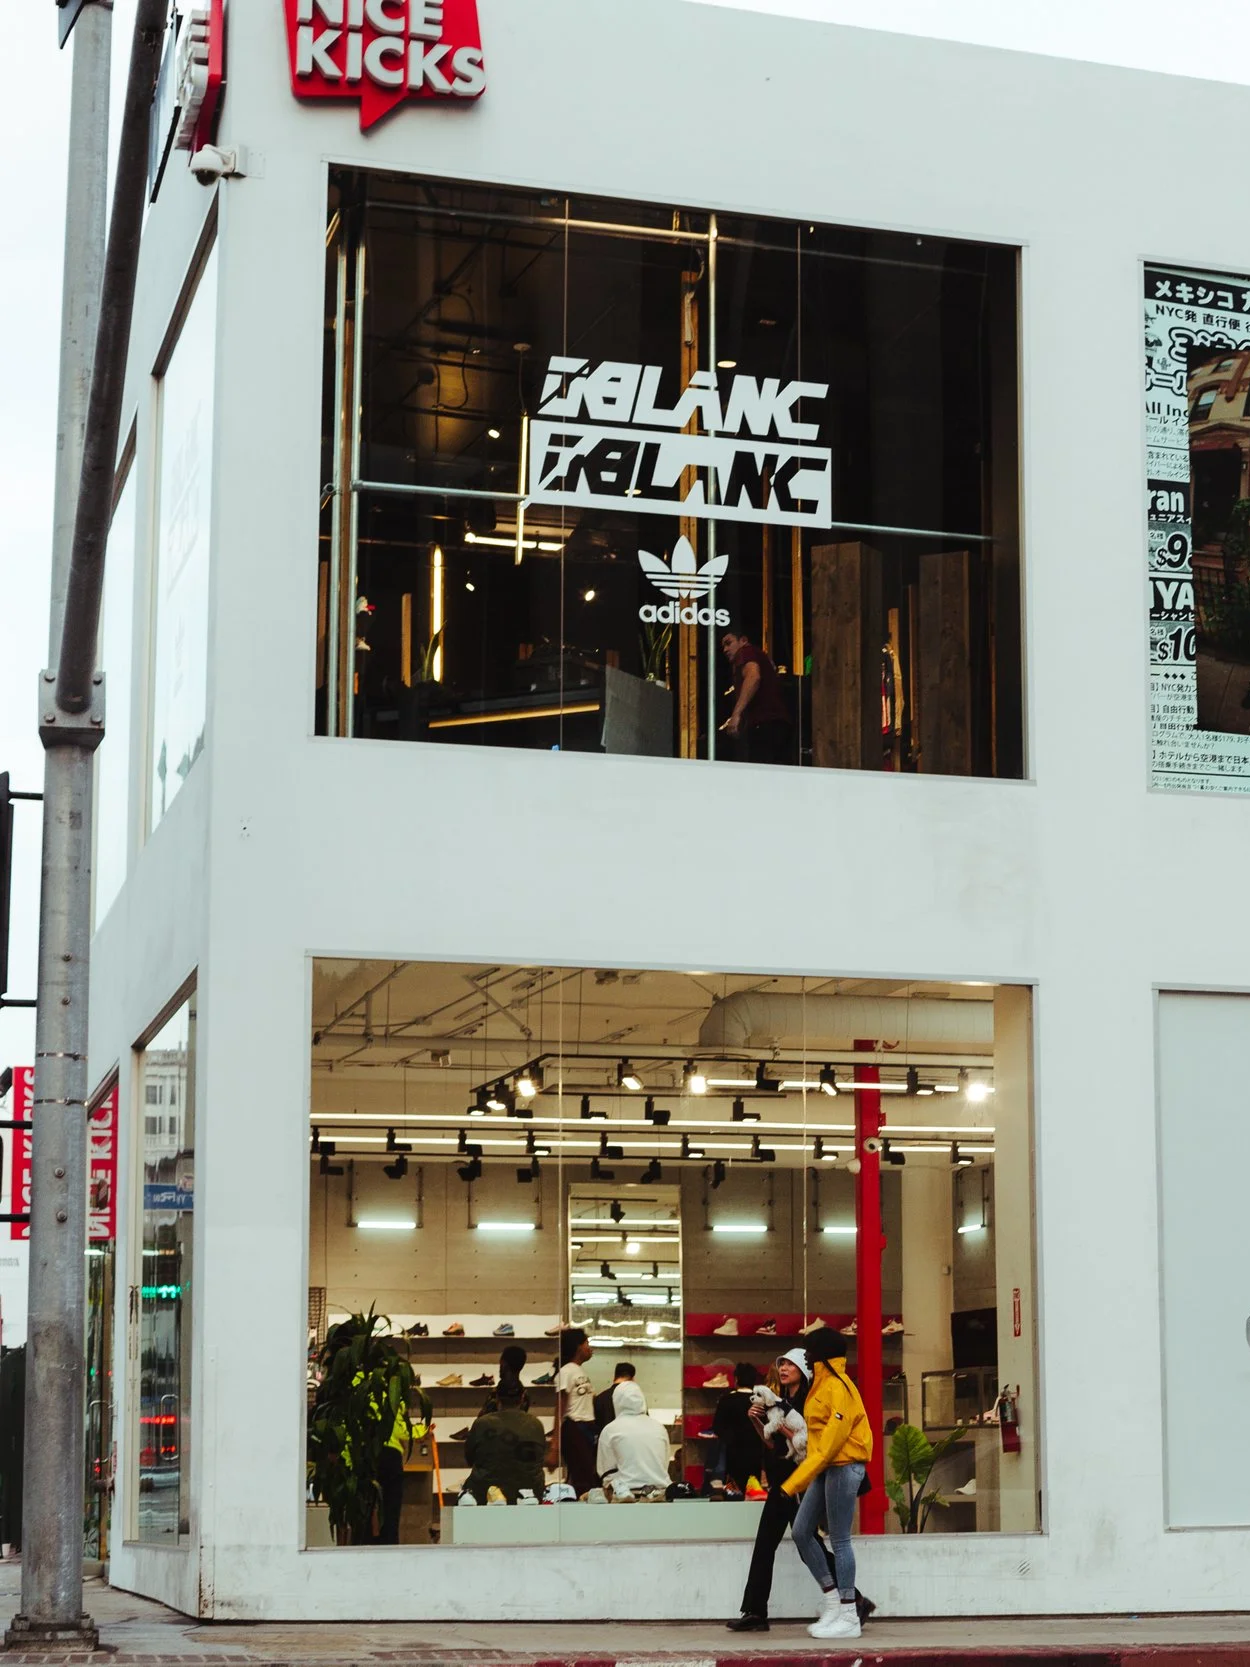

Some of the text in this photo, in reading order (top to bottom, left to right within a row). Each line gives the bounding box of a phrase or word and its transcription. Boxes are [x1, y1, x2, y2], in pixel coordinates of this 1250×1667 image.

[295, 25, 487, 97] KICKS
[1155, 280, 1235, 310] メキシコ
[1155, 304, 1198, 323] NYC発
[1156, 533, 1192, 569] $9
[638, 601, 731, 627] adidas
